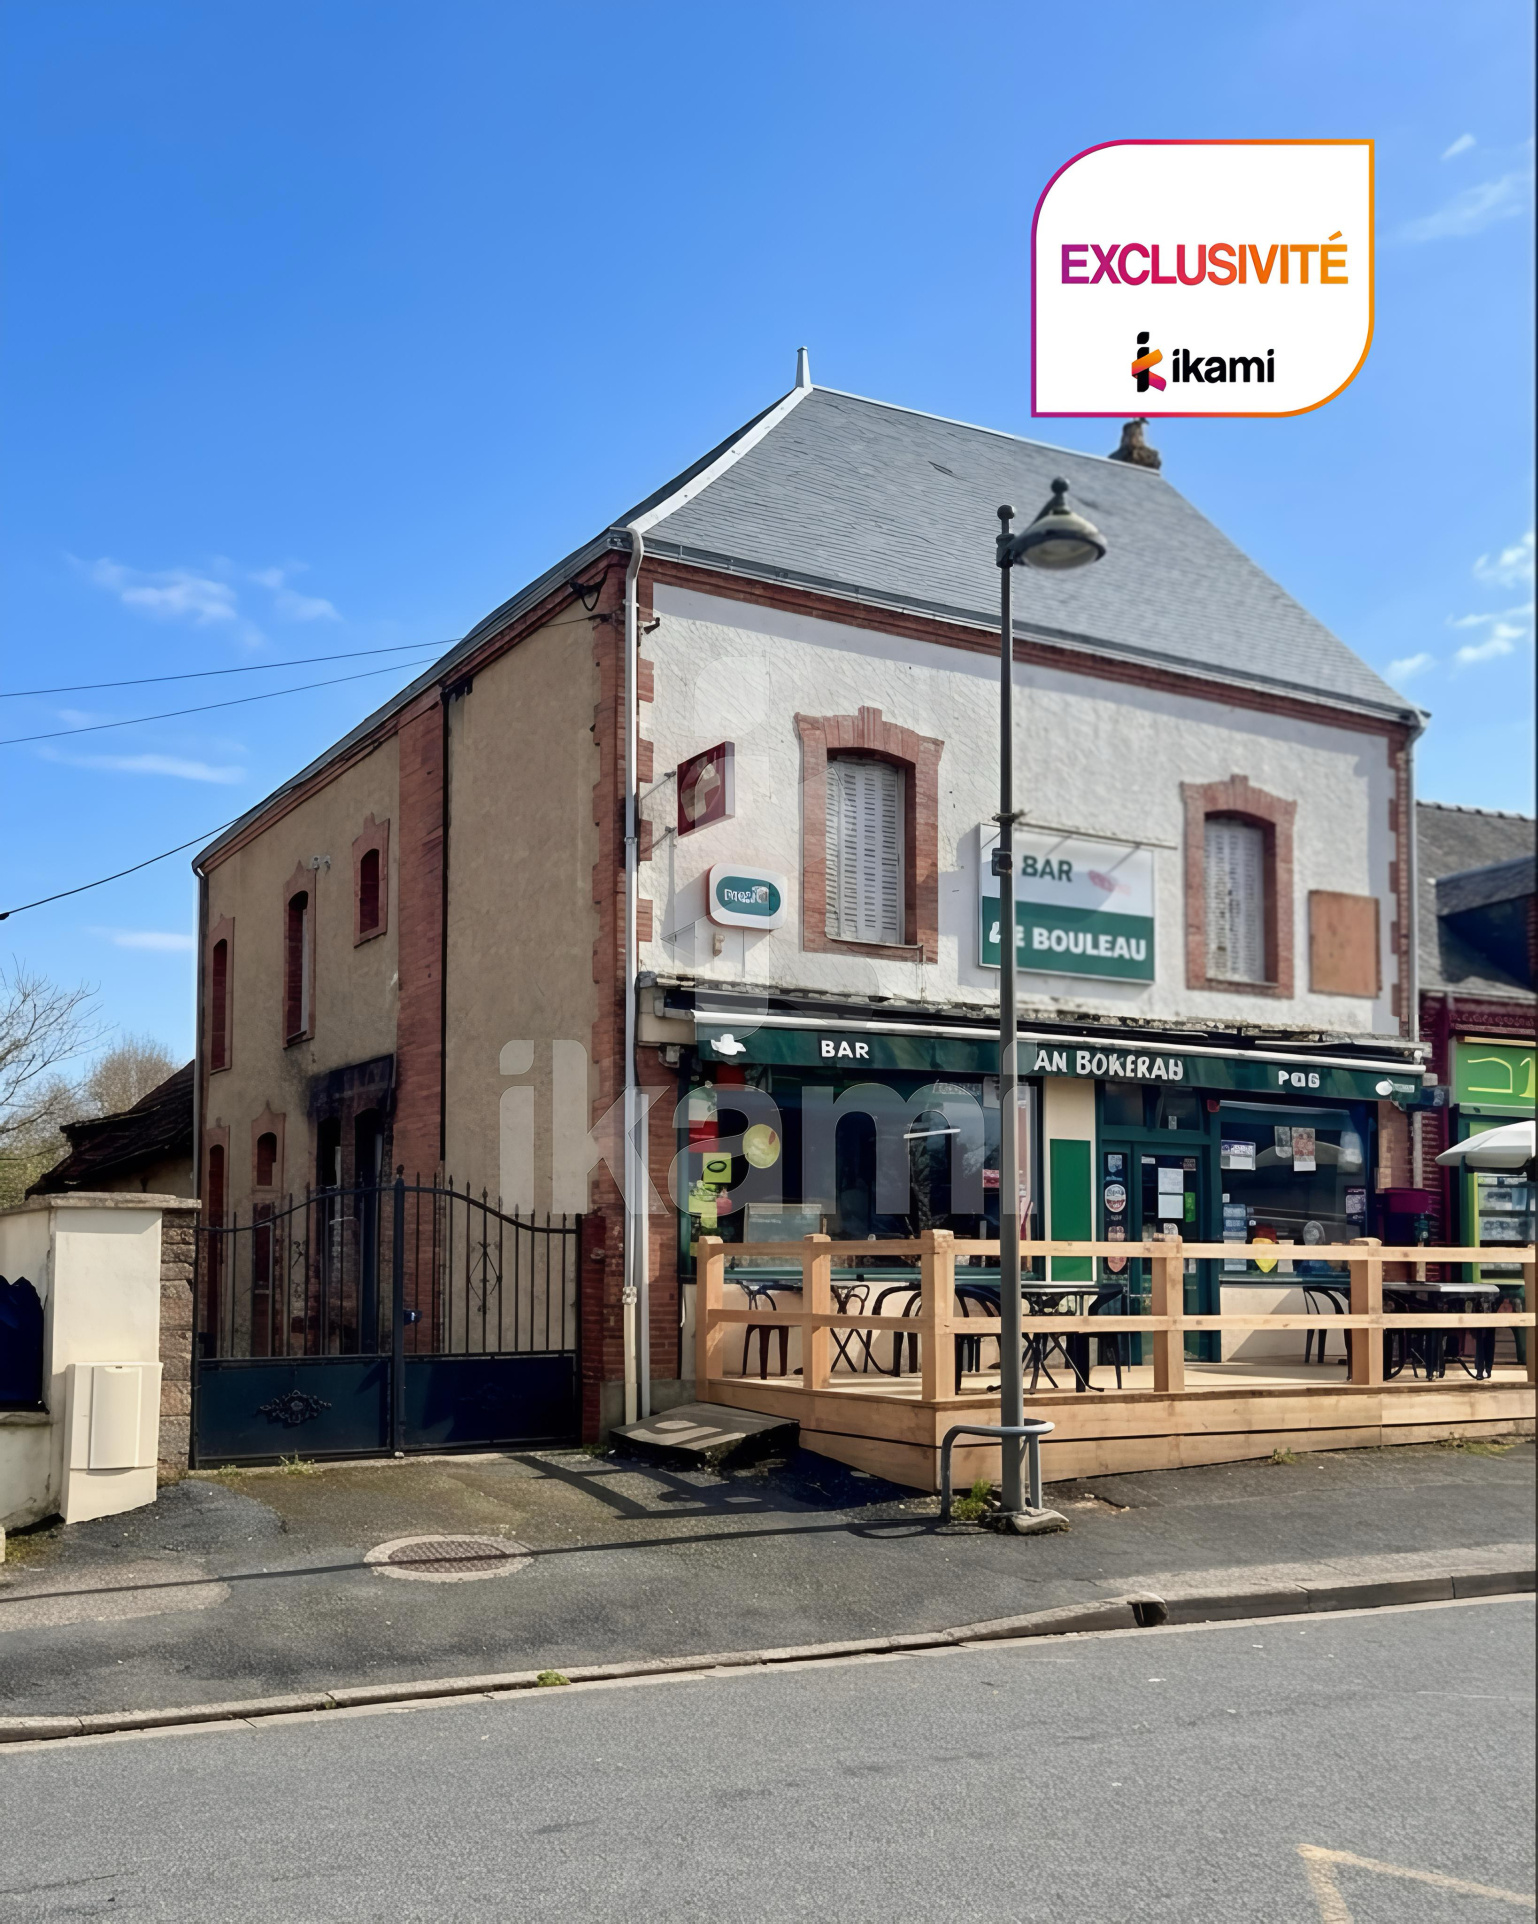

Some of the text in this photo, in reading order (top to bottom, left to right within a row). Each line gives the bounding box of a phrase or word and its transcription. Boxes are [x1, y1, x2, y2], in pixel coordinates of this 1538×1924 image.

[1022, 854, 1073, 883] BAR
[1032, 926, 1147, 961] BOULEAU
[821, 1040, 869, 1059] BAR
[1034, 1050, 1067, 1073] AN
